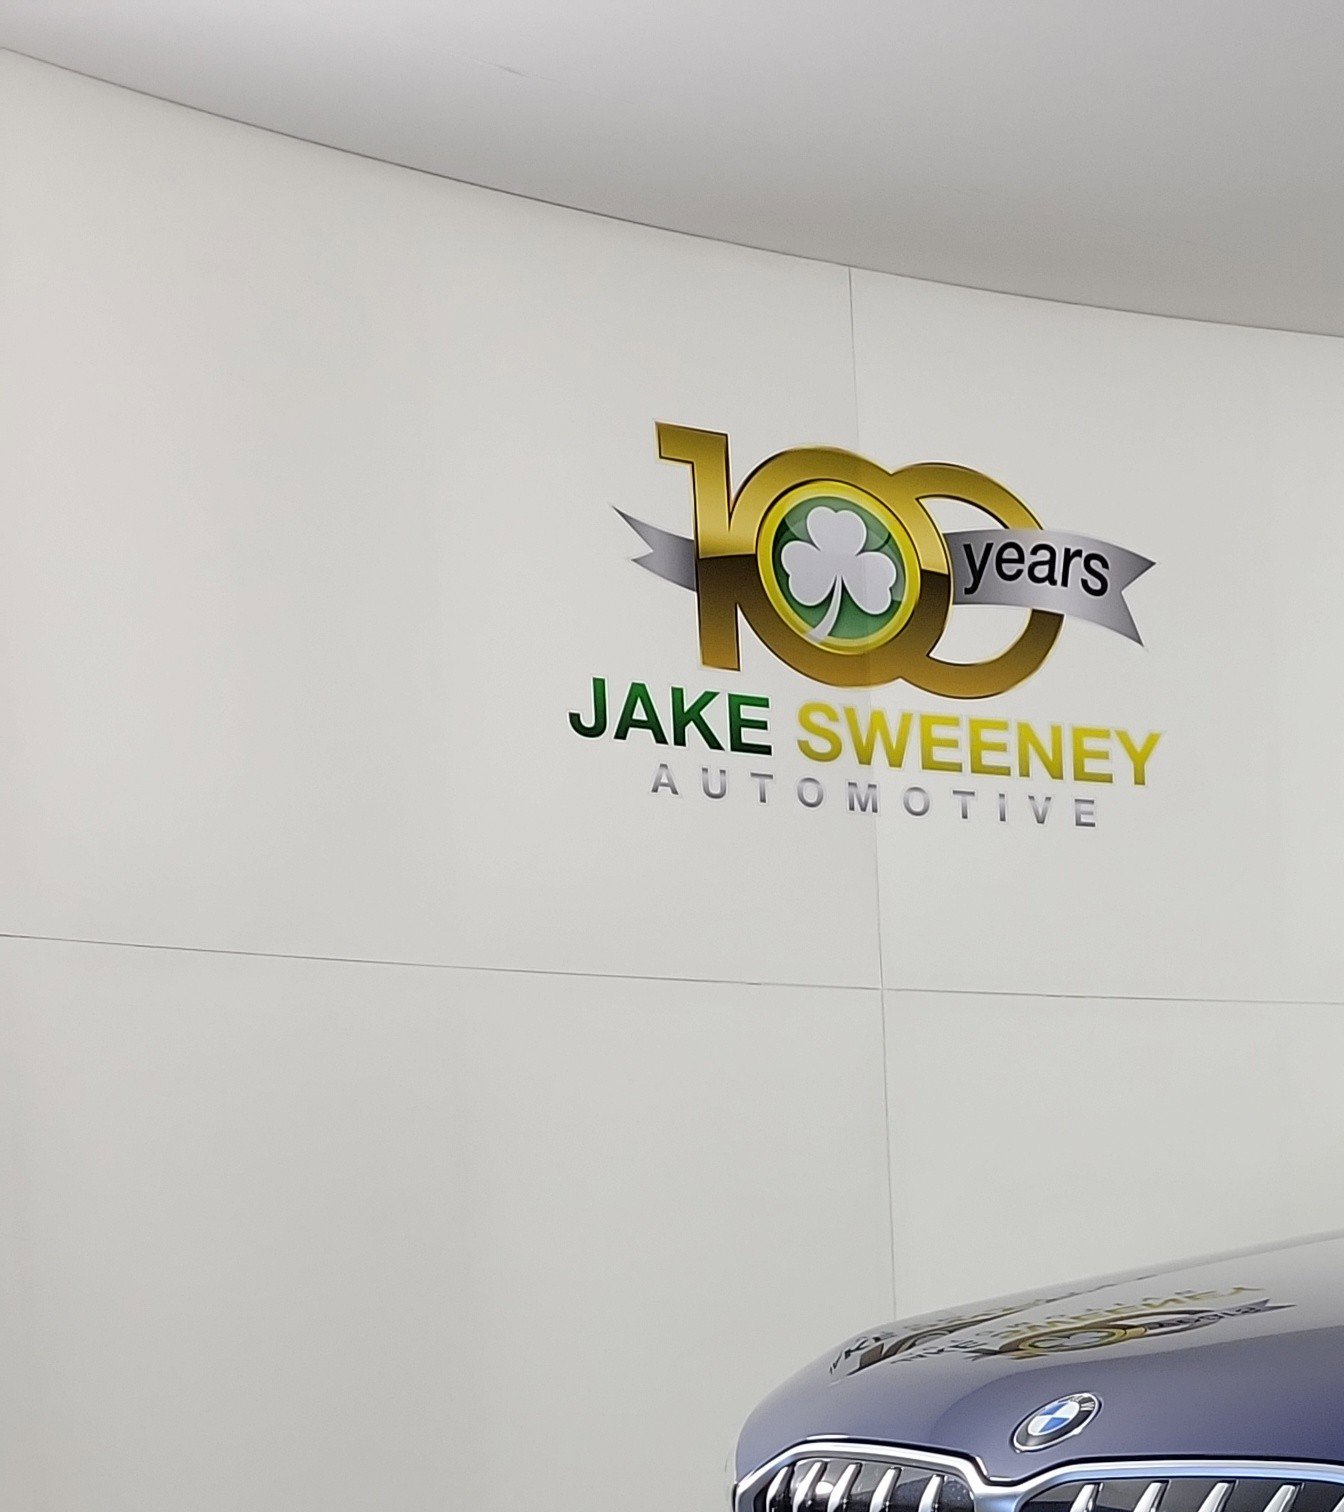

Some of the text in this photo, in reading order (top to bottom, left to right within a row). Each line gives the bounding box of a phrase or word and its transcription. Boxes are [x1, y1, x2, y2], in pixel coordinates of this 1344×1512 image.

[962, 538, 1110, 597] years
[567, 676, 1163, 787] JAKE SWEENEY
[651, 763, 1097, 828] AUTOMOTIVE
